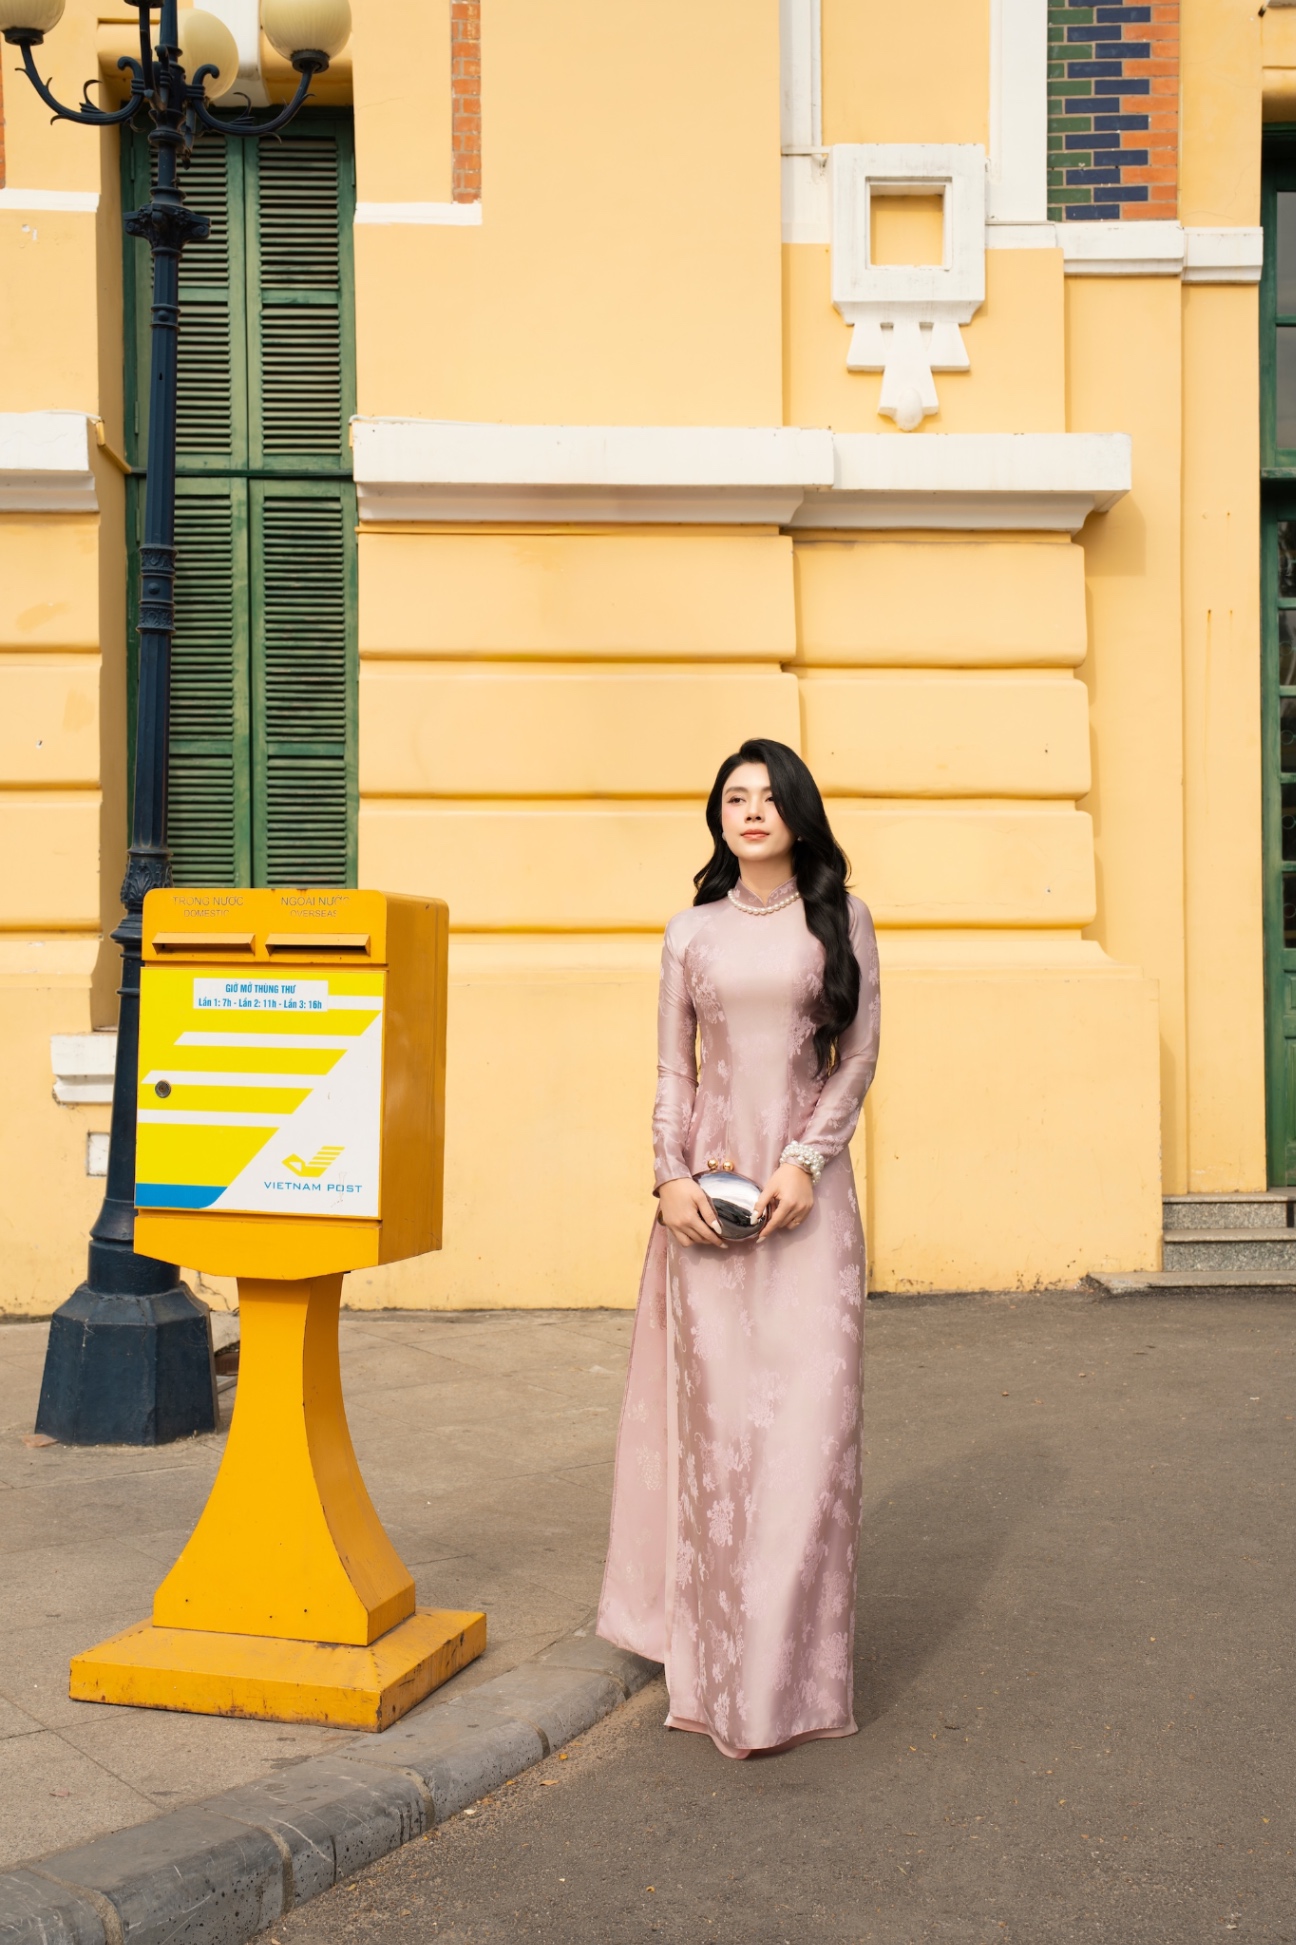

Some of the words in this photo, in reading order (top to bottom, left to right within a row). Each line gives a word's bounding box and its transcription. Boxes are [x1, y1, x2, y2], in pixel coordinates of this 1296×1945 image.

[173, 896, 210, 906] TRONG
[183, 909, 230, 917] DOMESTIC
[290, 909, 338, 918] OVERSEAS
[281, 984, 297, 994] THƯ
[214, 998, 221, 1007] 1:
[222, 998, 232, 1007] 7h
[253, 998, 261, 1008] 2:
[263, 999, 277, 1008] 11h
[299, 1000, 306, 1009] 3:
[308, 1000, 322, 1009] 16h
[264, 1181, 321, 1191] VIETNAM
[327, 1183, 363, 1193] POST
